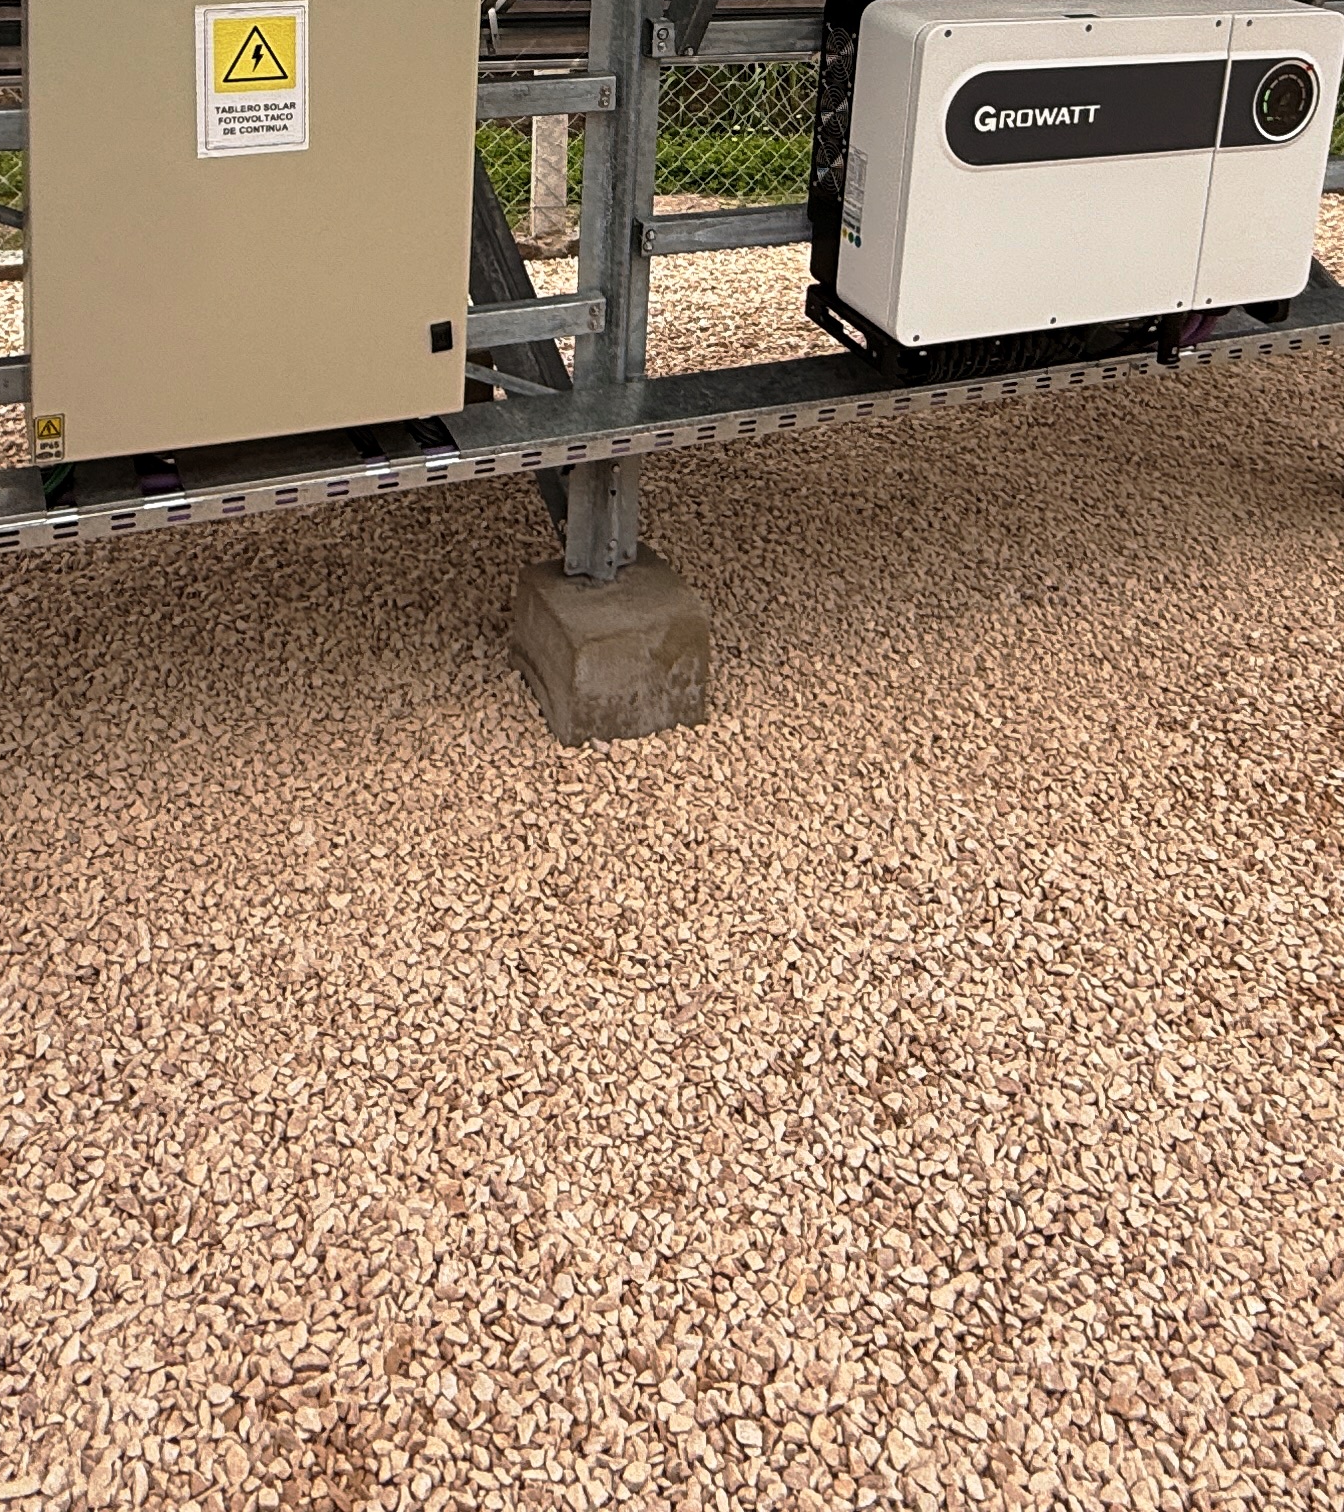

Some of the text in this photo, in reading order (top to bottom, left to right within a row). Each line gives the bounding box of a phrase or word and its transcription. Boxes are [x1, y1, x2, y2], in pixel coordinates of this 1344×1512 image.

[215, 102, 296, 114] TABLERO SOLAR
[218, 112, 294, 125] FOTOVOLTAICO
[974, 104, 1101, 132] GROWATT
[223, 123, 289, 135] DE CONTINUA
